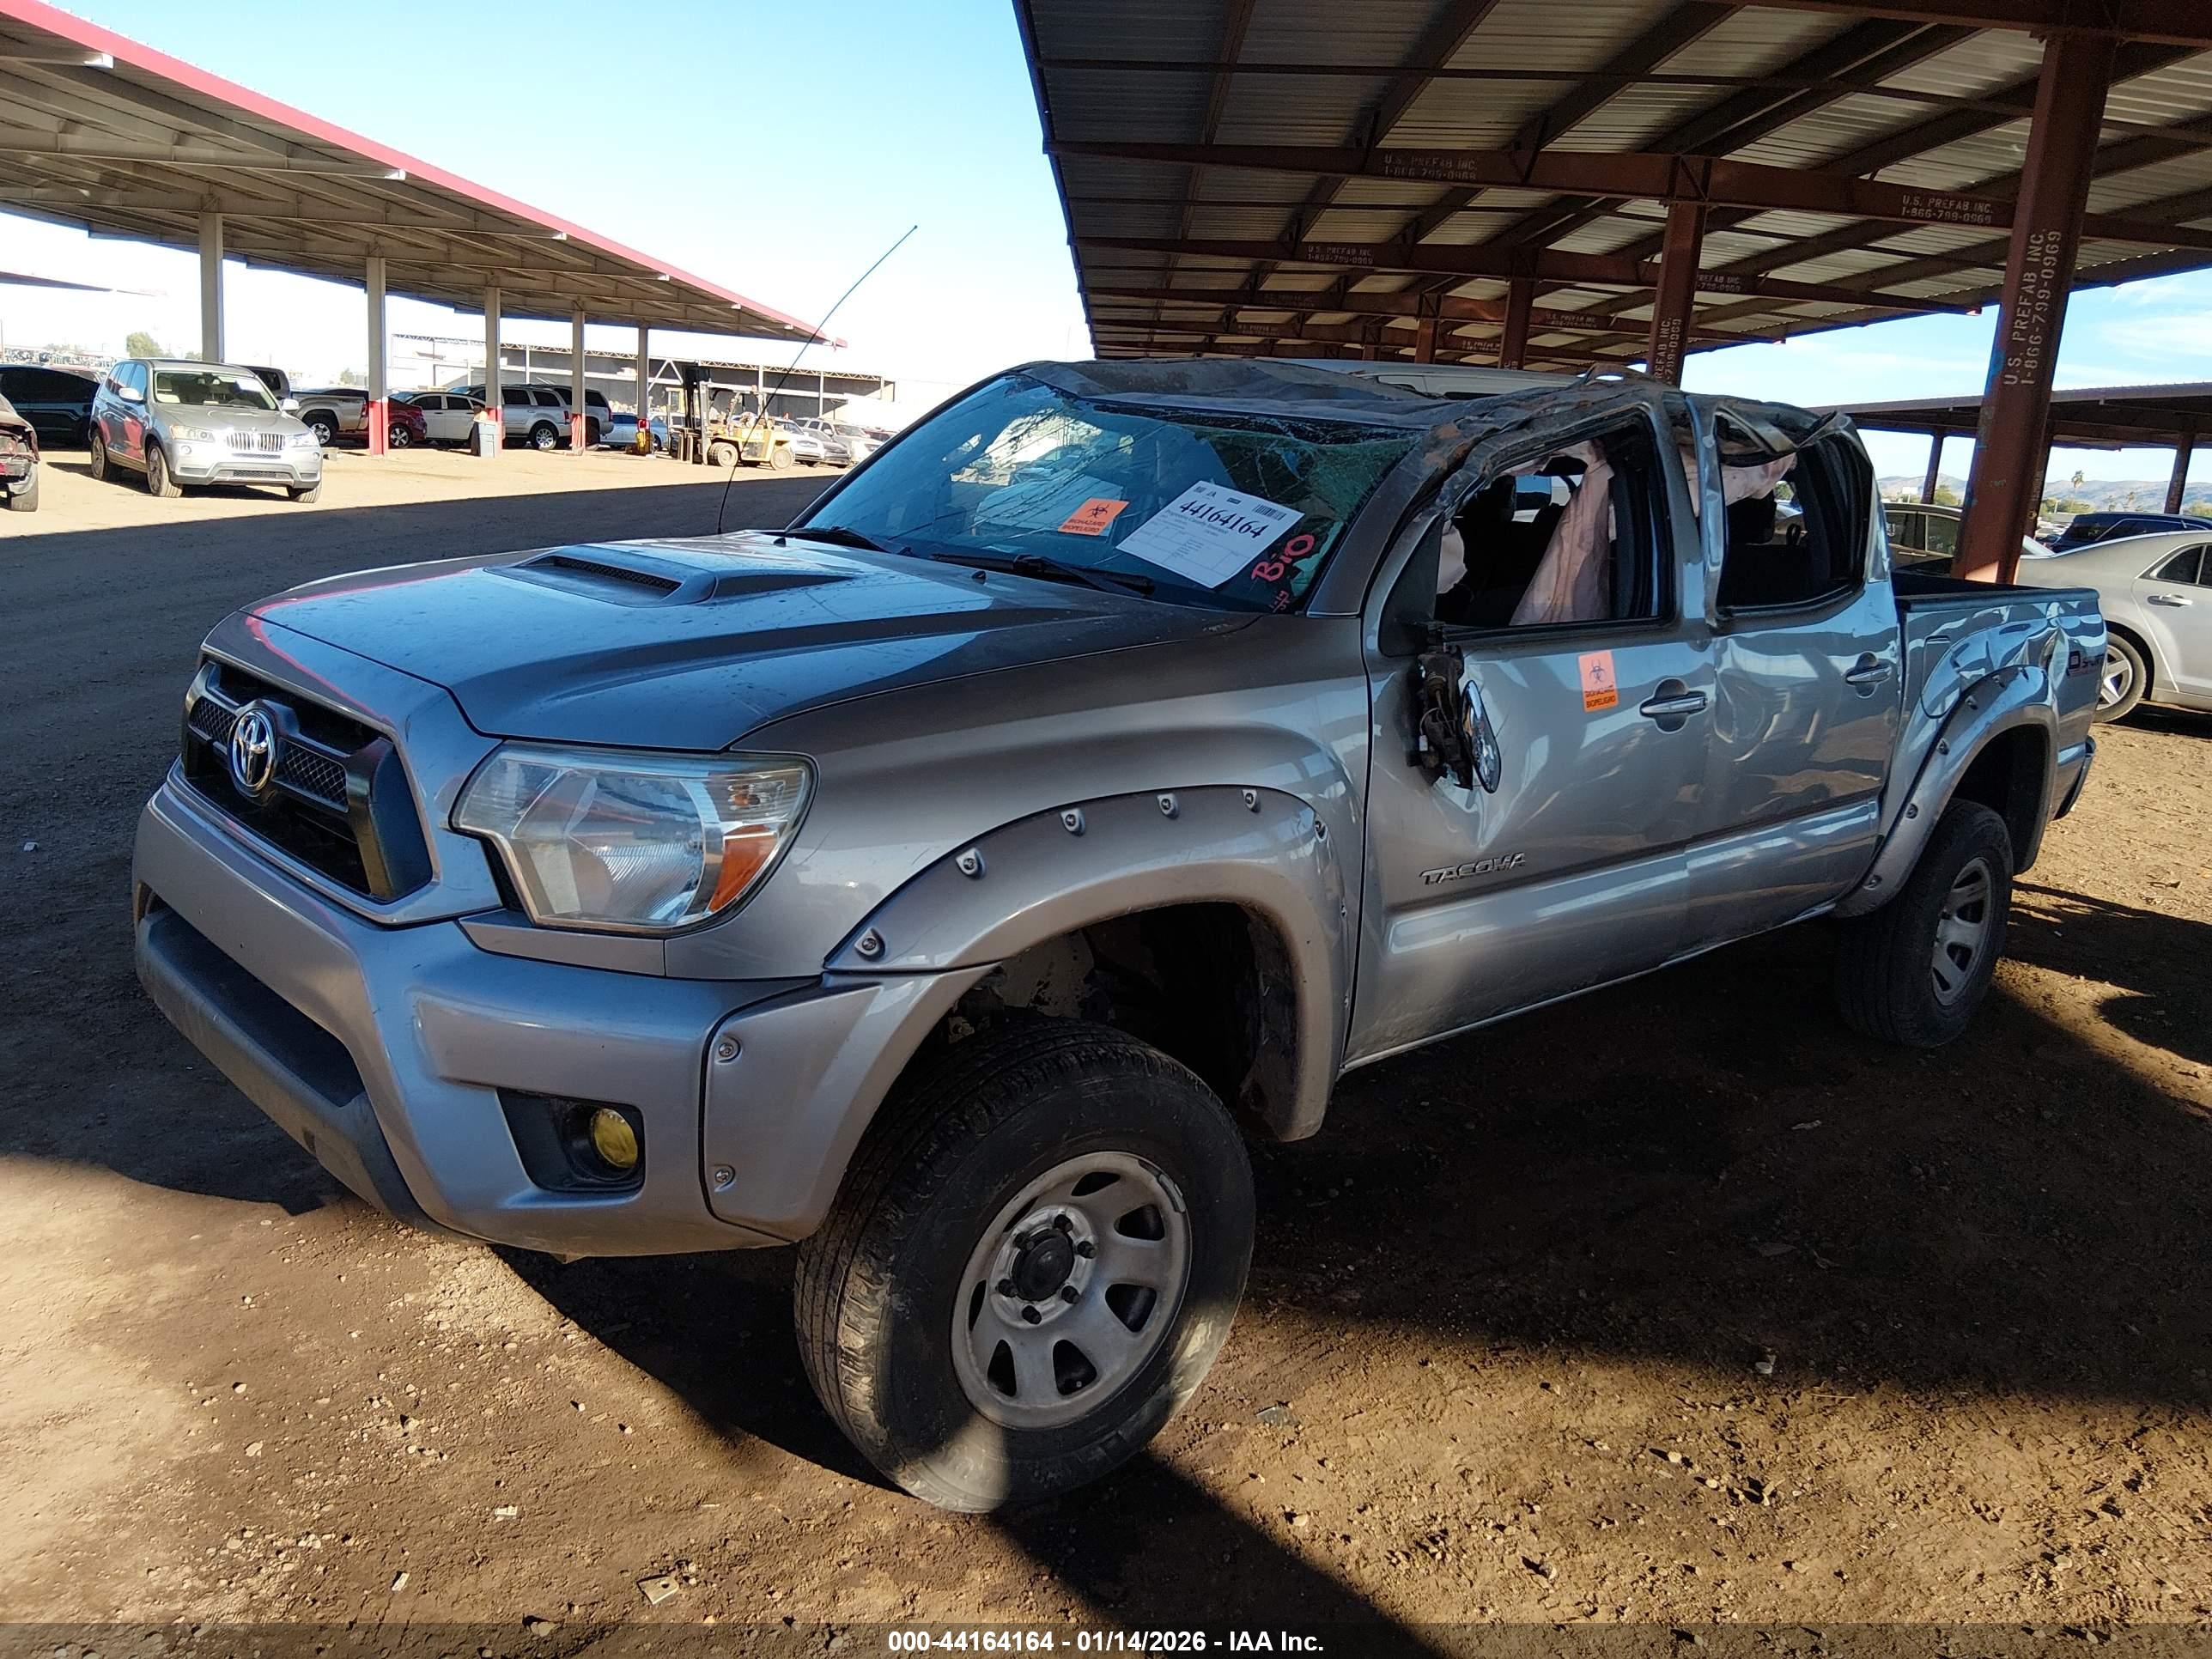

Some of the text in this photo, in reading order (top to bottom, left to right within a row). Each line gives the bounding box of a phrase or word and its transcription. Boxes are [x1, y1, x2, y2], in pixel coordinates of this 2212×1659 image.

[1902, 195, 1923, 207] U.S.
[1928, 198, 1970, 211] PREFAB
[2003, 228, 2046, 385] U.S. PREFAB INC.
[2021, 231, 2061, 385] 1-866-799-0969
[1655, 344, 1668, 378] REFAB
[1179, 500, 1270, 540] 44164164
[1419, 851, 1526, 885] TACOMA
